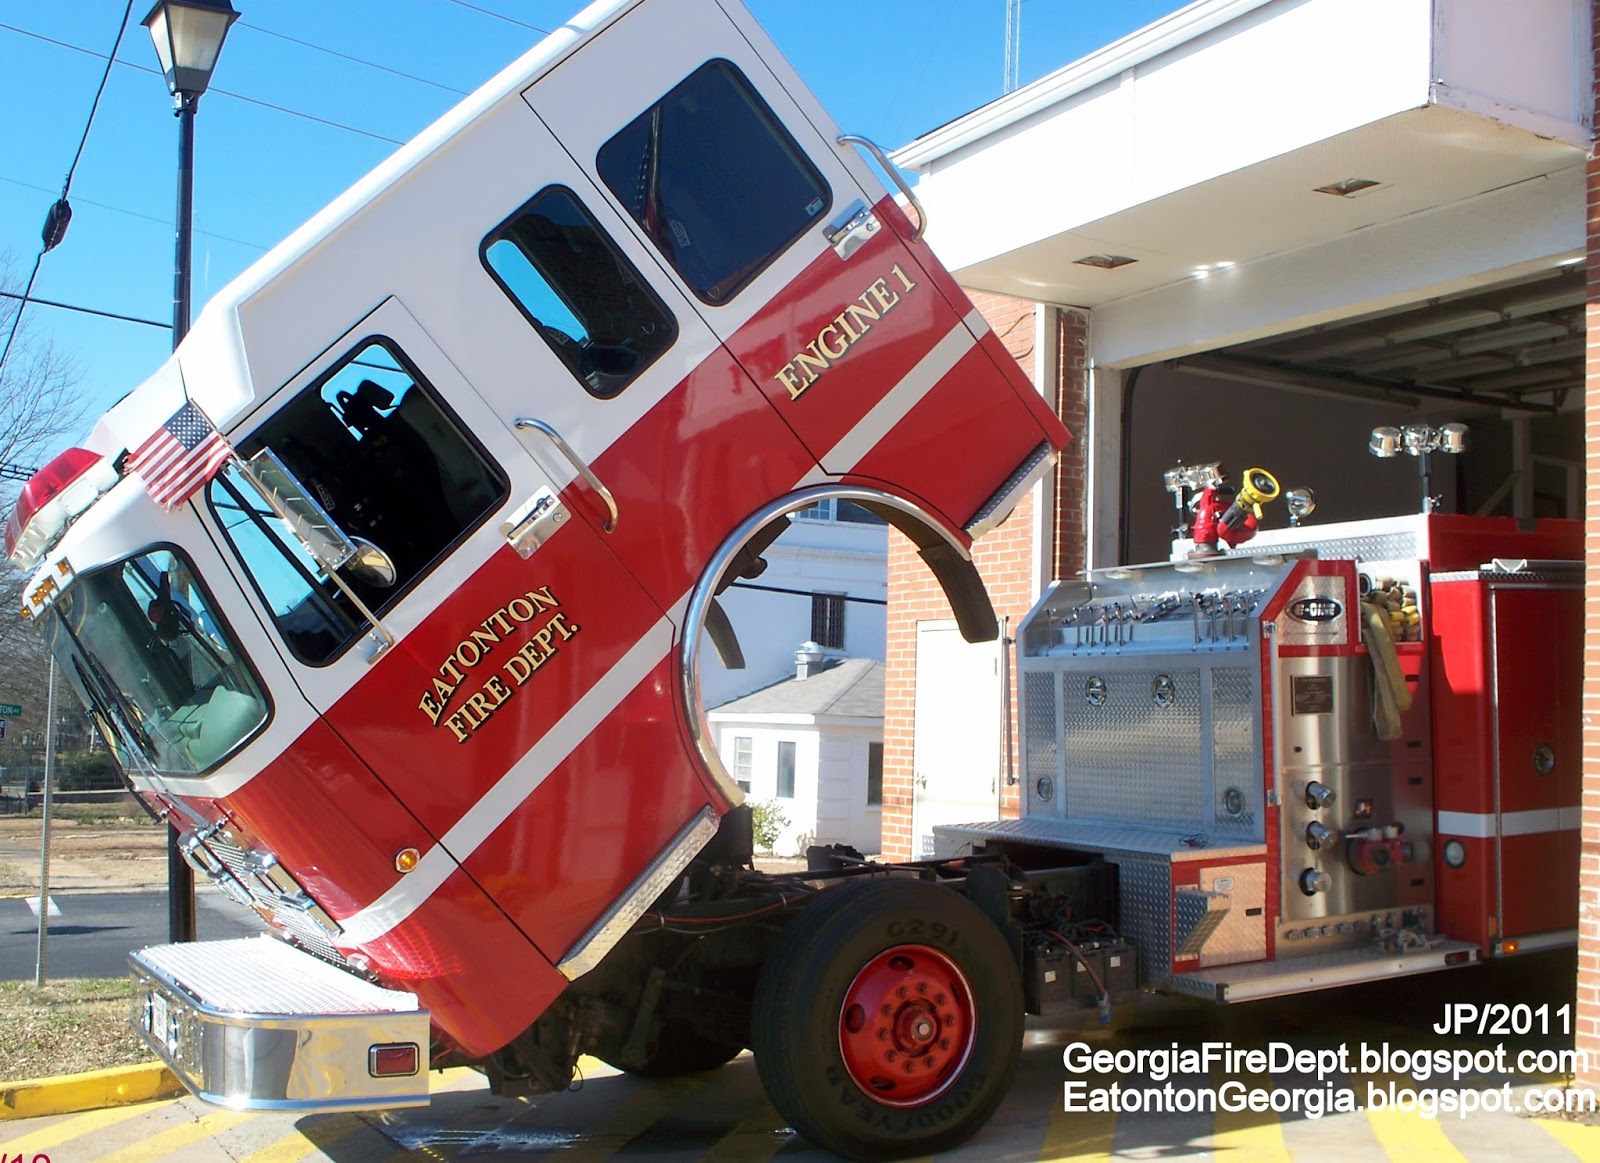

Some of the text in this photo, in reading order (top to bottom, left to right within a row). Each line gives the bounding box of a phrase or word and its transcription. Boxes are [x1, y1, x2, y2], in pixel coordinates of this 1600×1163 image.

[774, 263, 916, 401] ENGINE 1
[418, 586, 560, 726] EATONTON
[443, 612, 581, 743] FIRE DEPT.
